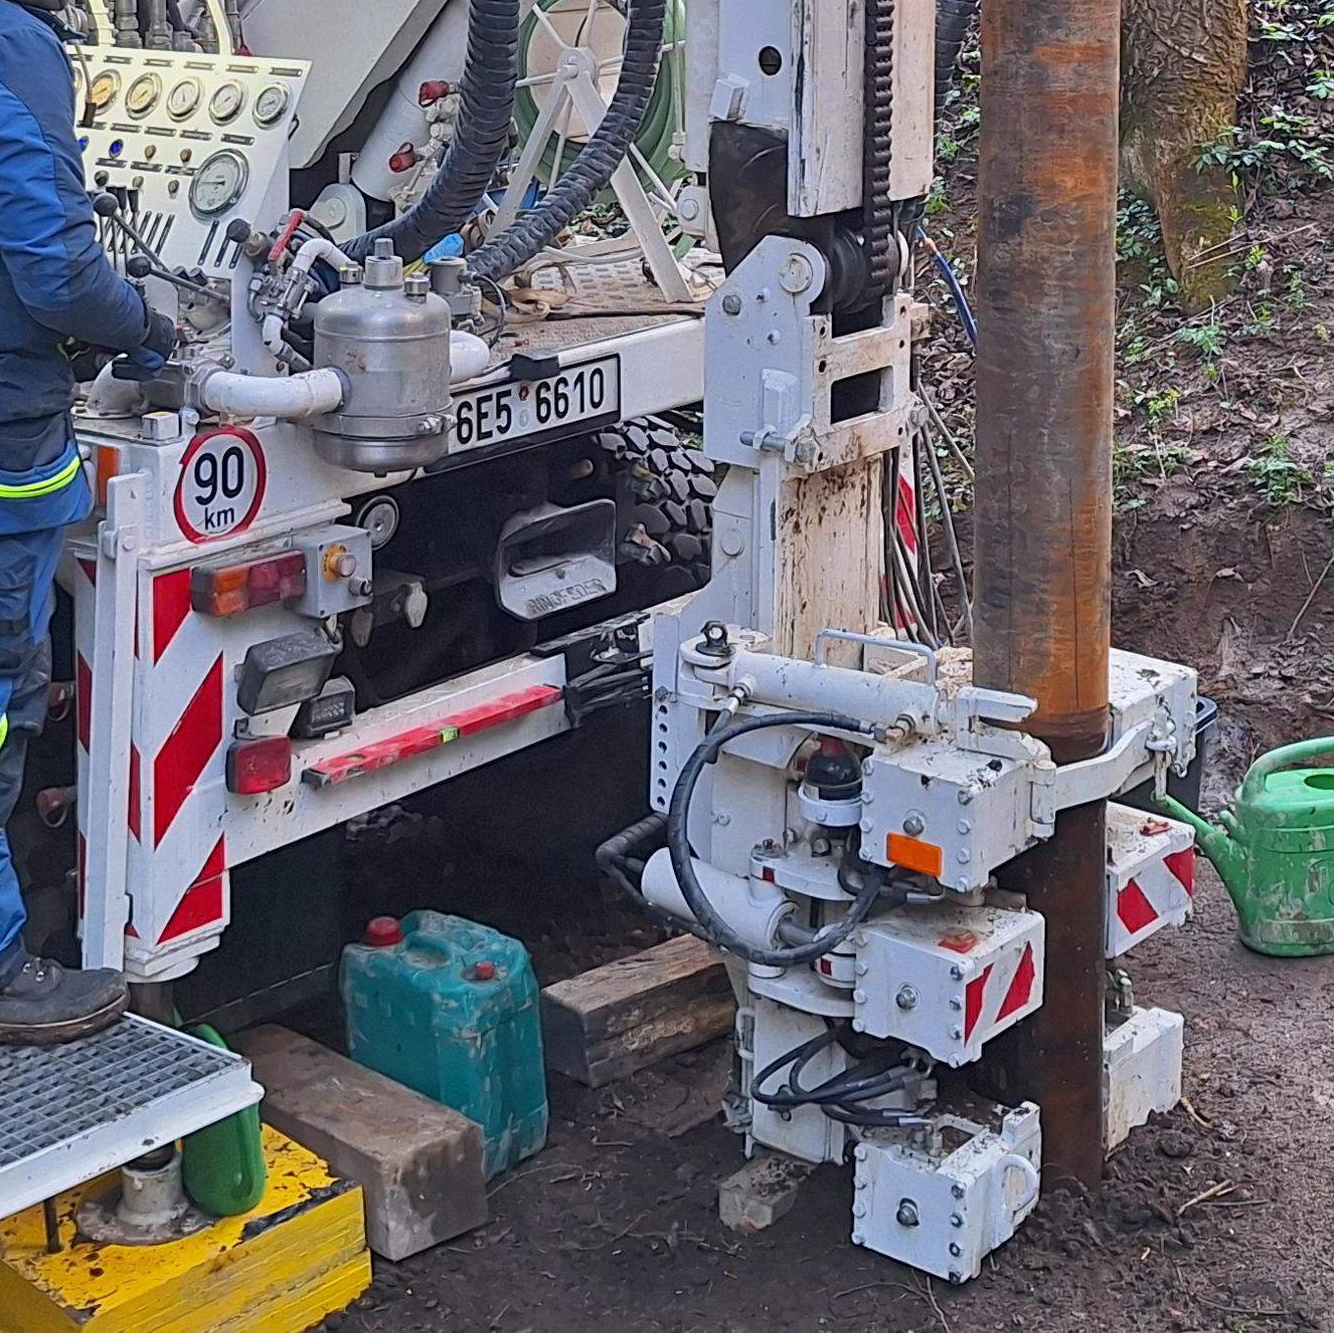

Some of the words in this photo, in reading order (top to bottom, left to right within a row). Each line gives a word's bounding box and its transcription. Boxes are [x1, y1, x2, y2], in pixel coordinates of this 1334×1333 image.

[456, 389, 512, 445] 6E5
[535, 367, 604, 424] 6610
[194, 446, 244, 506] 90
[204, 507, 235, 530] km
